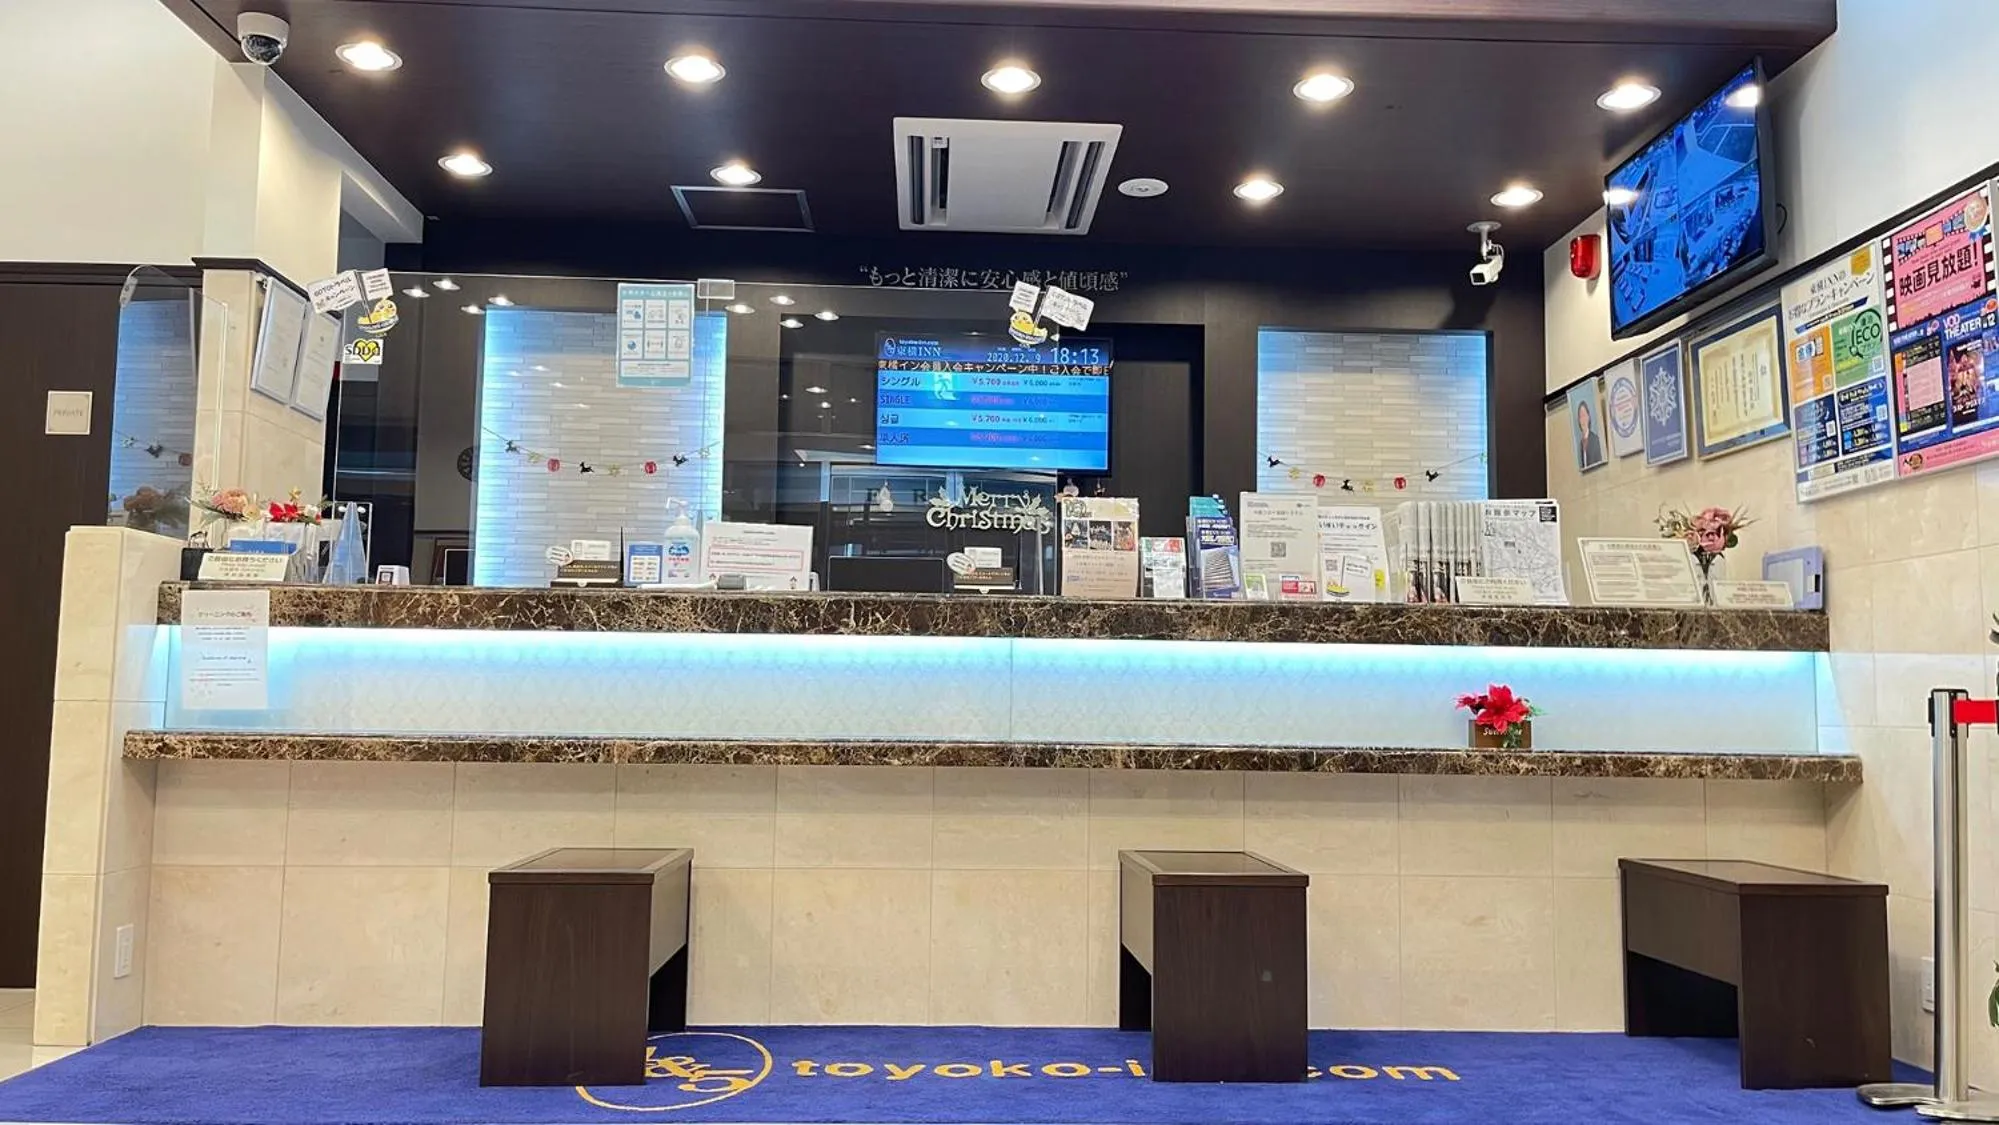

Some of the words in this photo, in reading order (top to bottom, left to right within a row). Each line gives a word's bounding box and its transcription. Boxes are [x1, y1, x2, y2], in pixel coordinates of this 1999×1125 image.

[1856, 323, 1881, 345] ECO
[1944, 317, 1981, 340] THEATER
[1050, 347, 1099, 365] 18:13
[881, 376, 920, 387] シングル
[957, 485, 1031, 511] Merry
[926, 505, 1053, 534] Christmas
